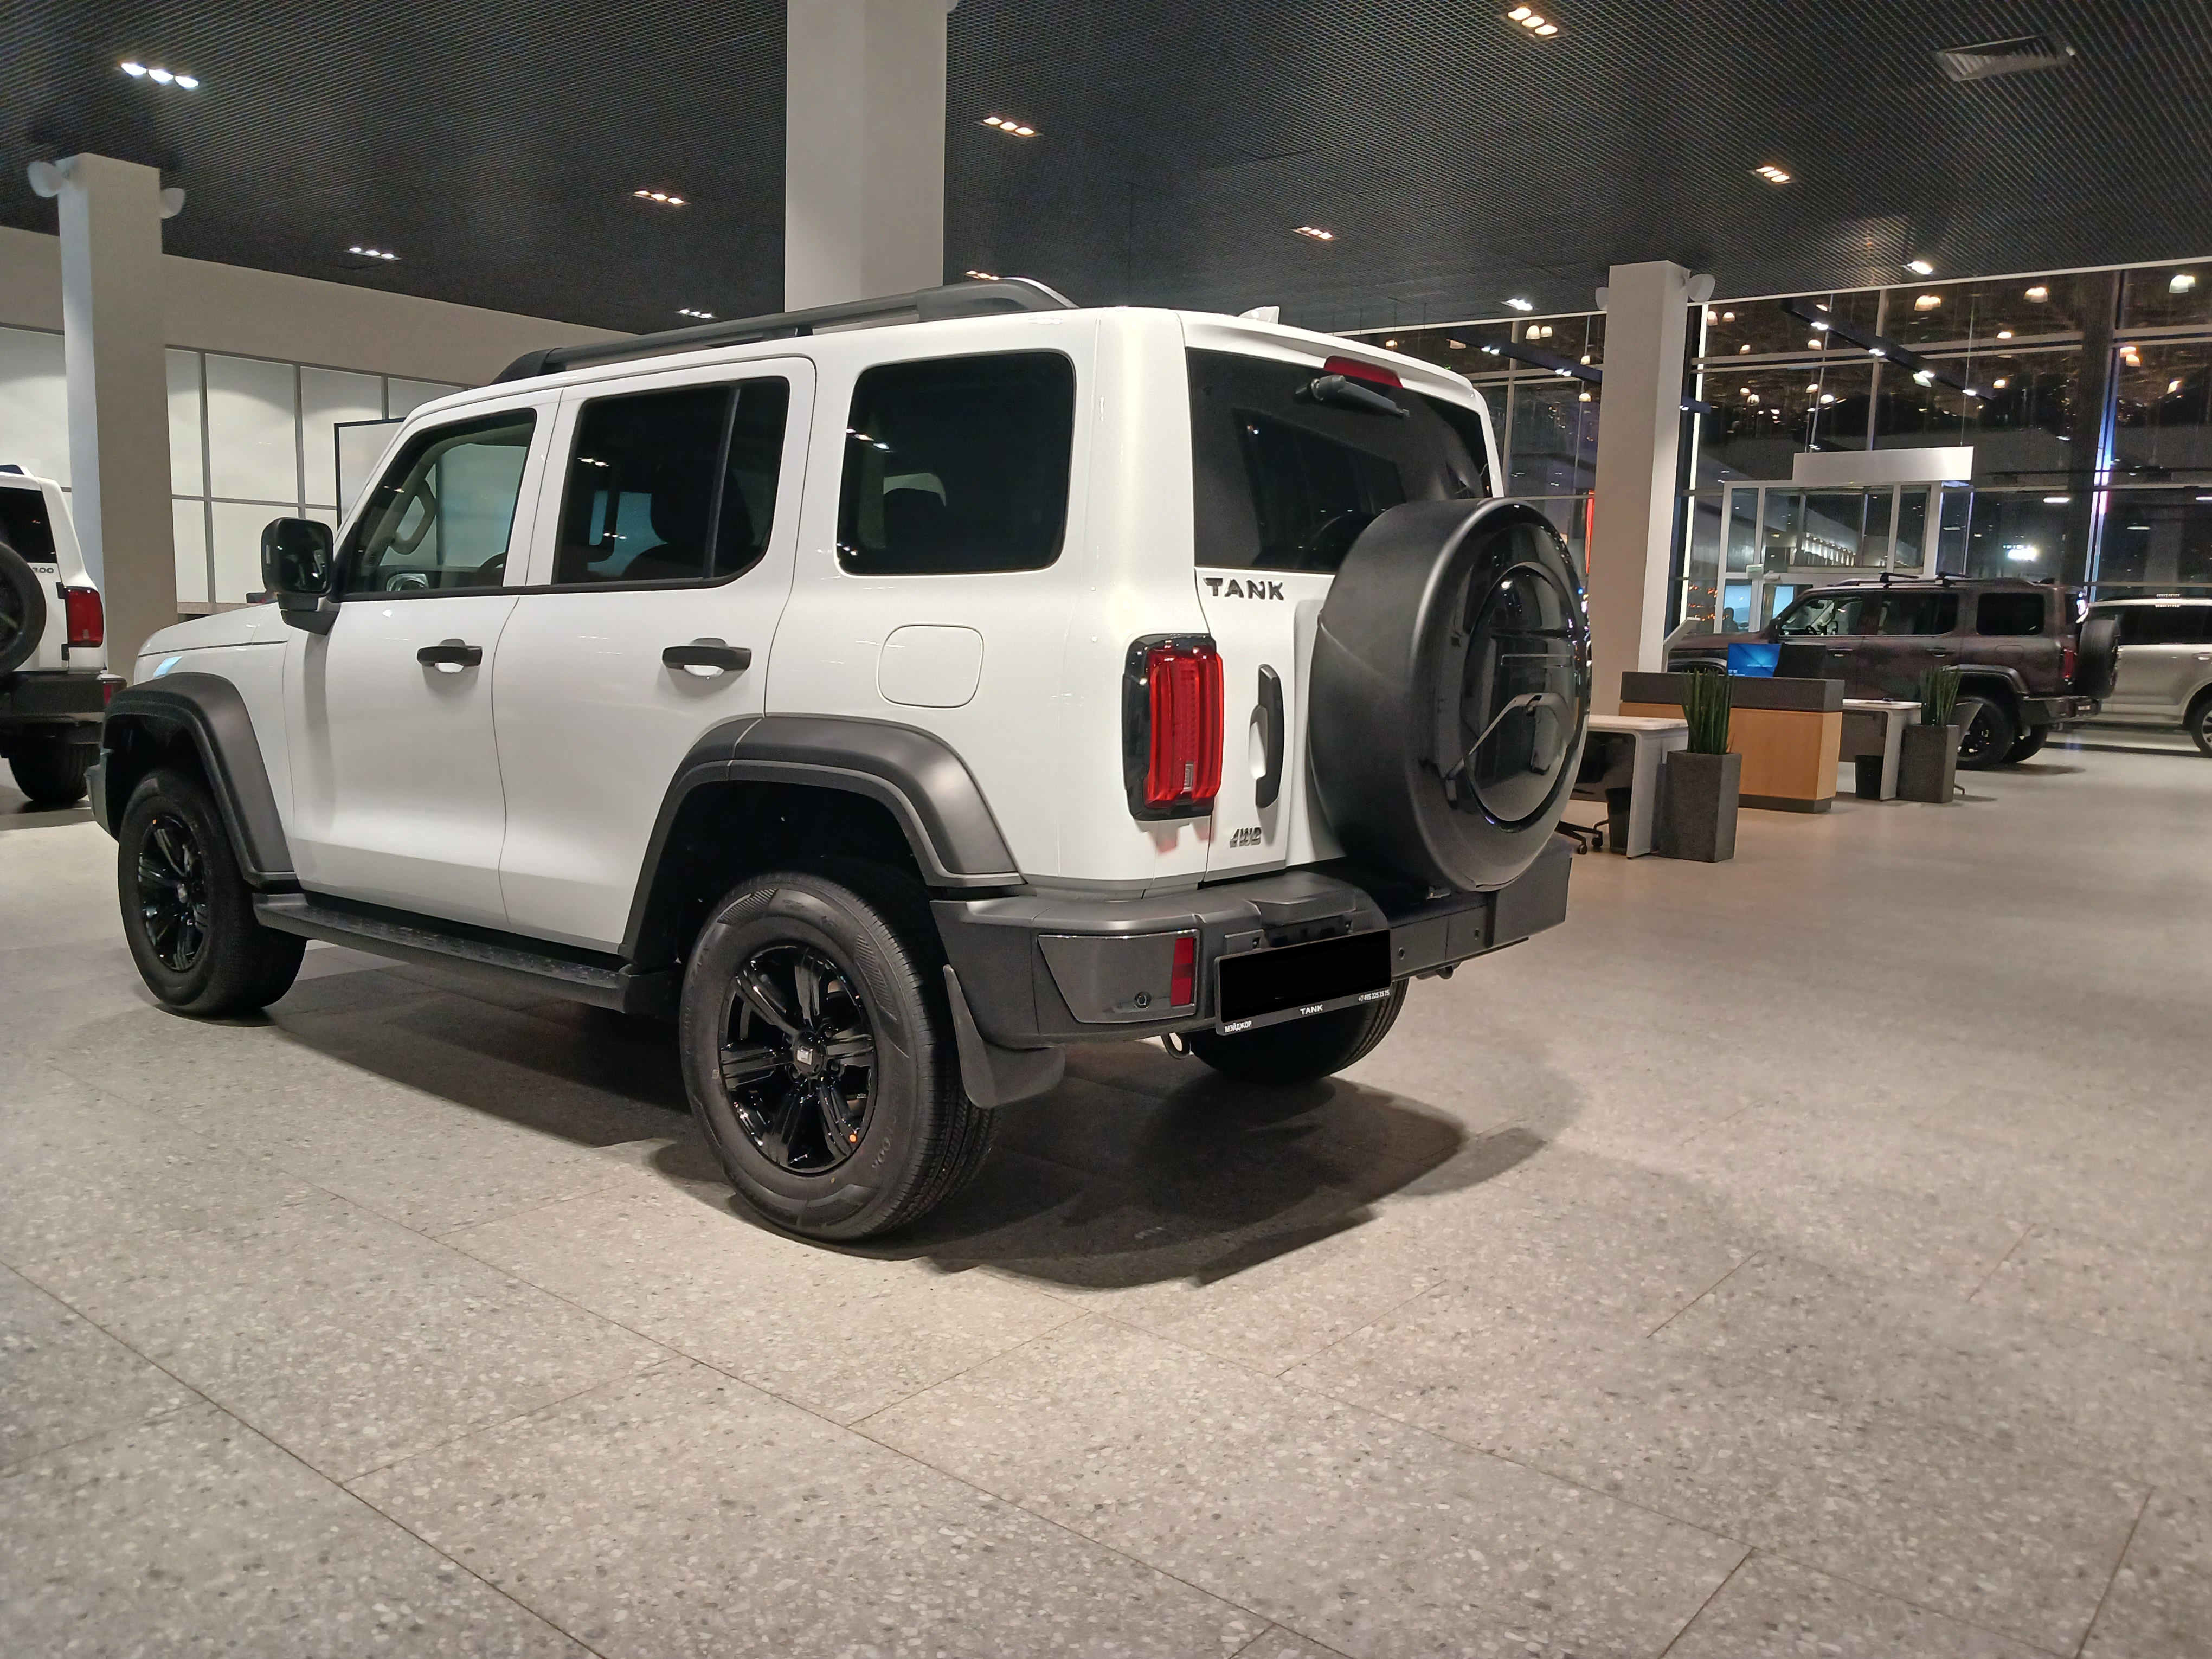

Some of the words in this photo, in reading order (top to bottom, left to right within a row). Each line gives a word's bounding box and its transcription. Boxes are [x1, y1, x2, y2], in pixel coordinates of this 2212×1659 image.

[1203, 577, 1284, 601] TANK
[1300, 1004, 1323, 1015] TANK
[1225, 1020, 1252, 1033] МЭЙДЖОР
